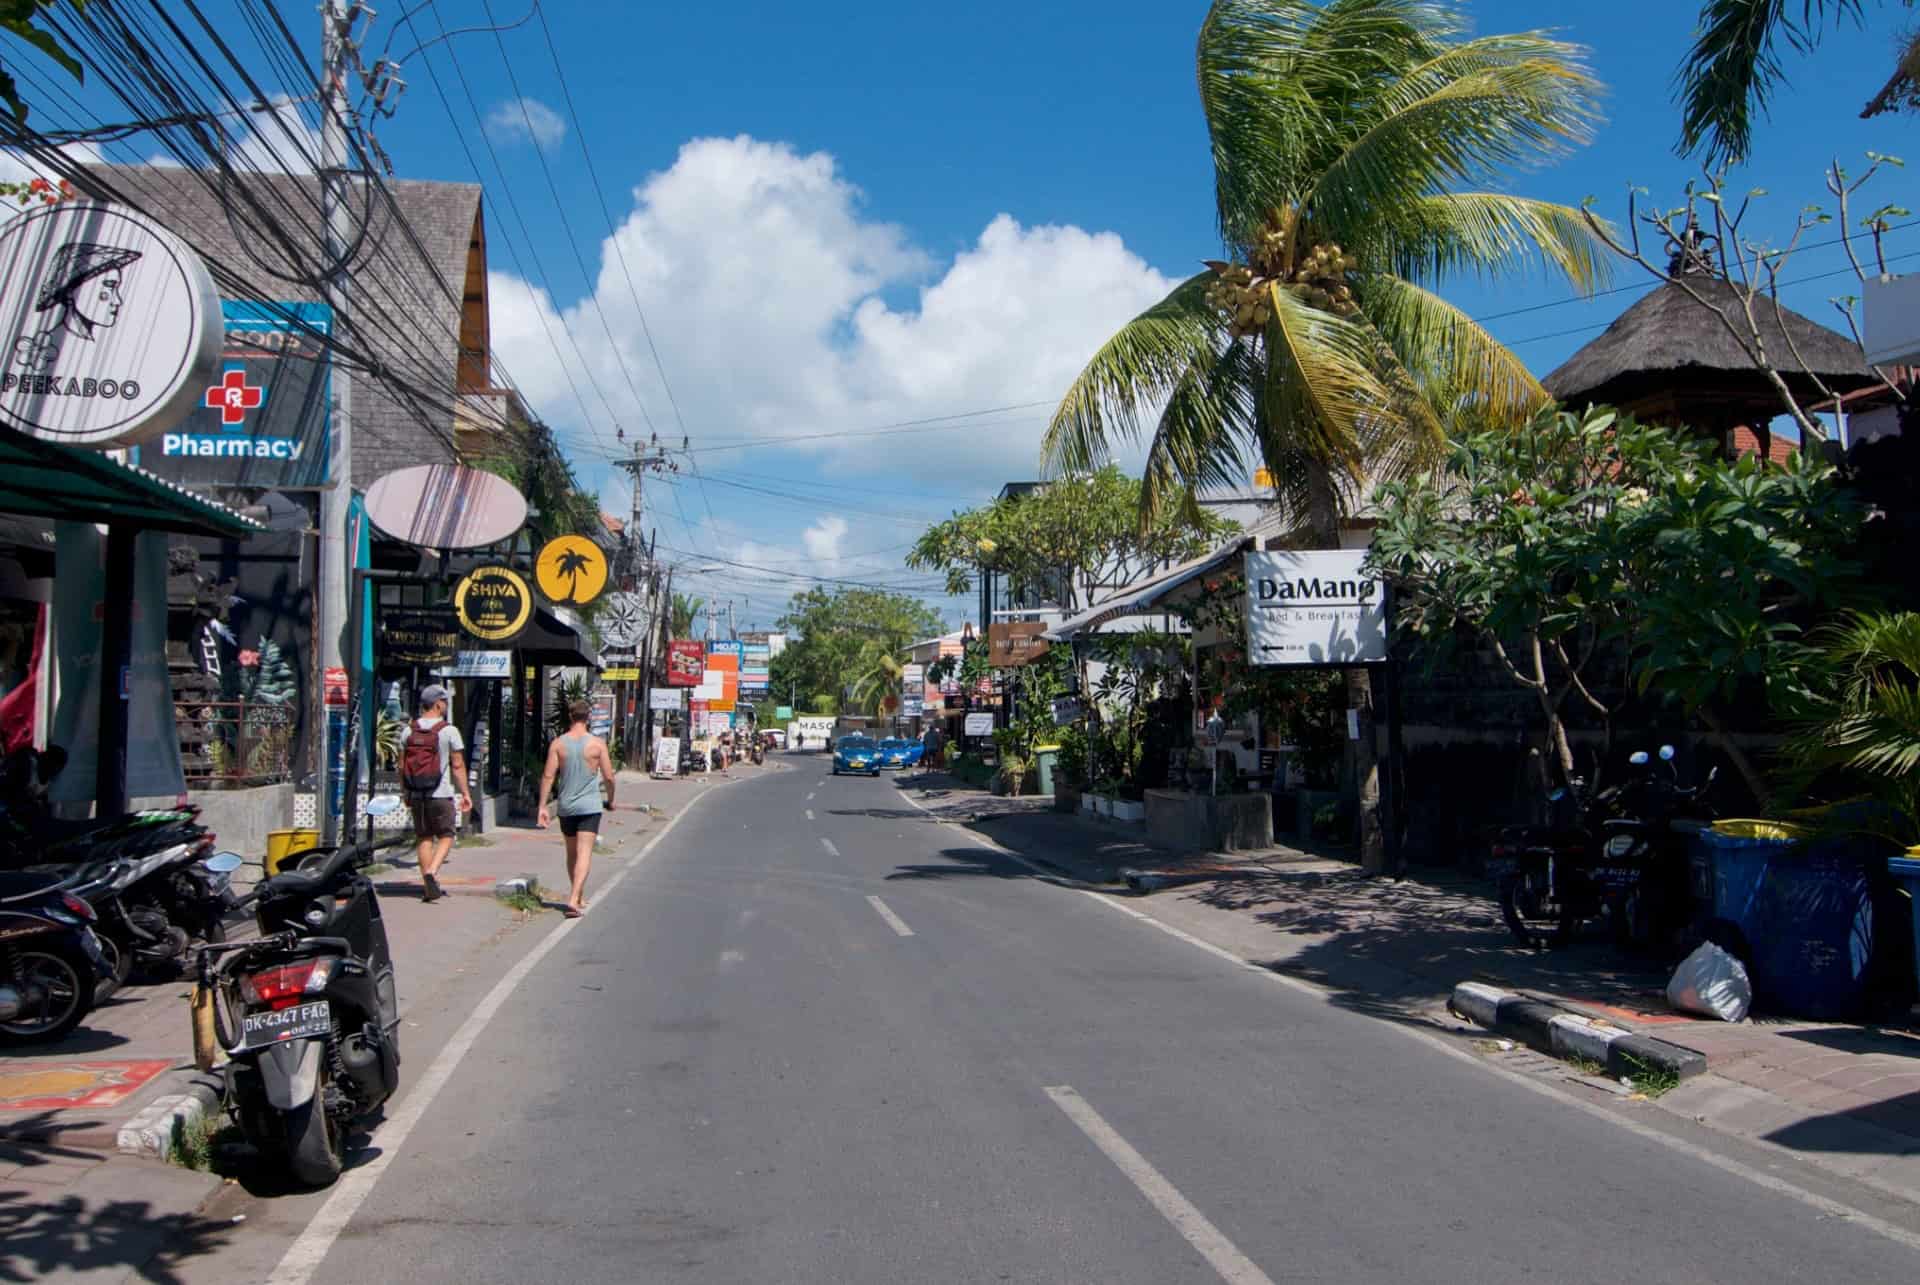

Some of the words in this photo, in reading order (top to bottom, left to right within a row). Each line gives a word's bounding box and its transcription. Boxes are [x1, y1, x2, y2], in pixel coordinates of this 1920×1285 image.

[2, 373, 140, 400] PEEKABOO
[163, 434, 304, 460] Pharmacy
[472, 583, 517, 597] SHIVA
